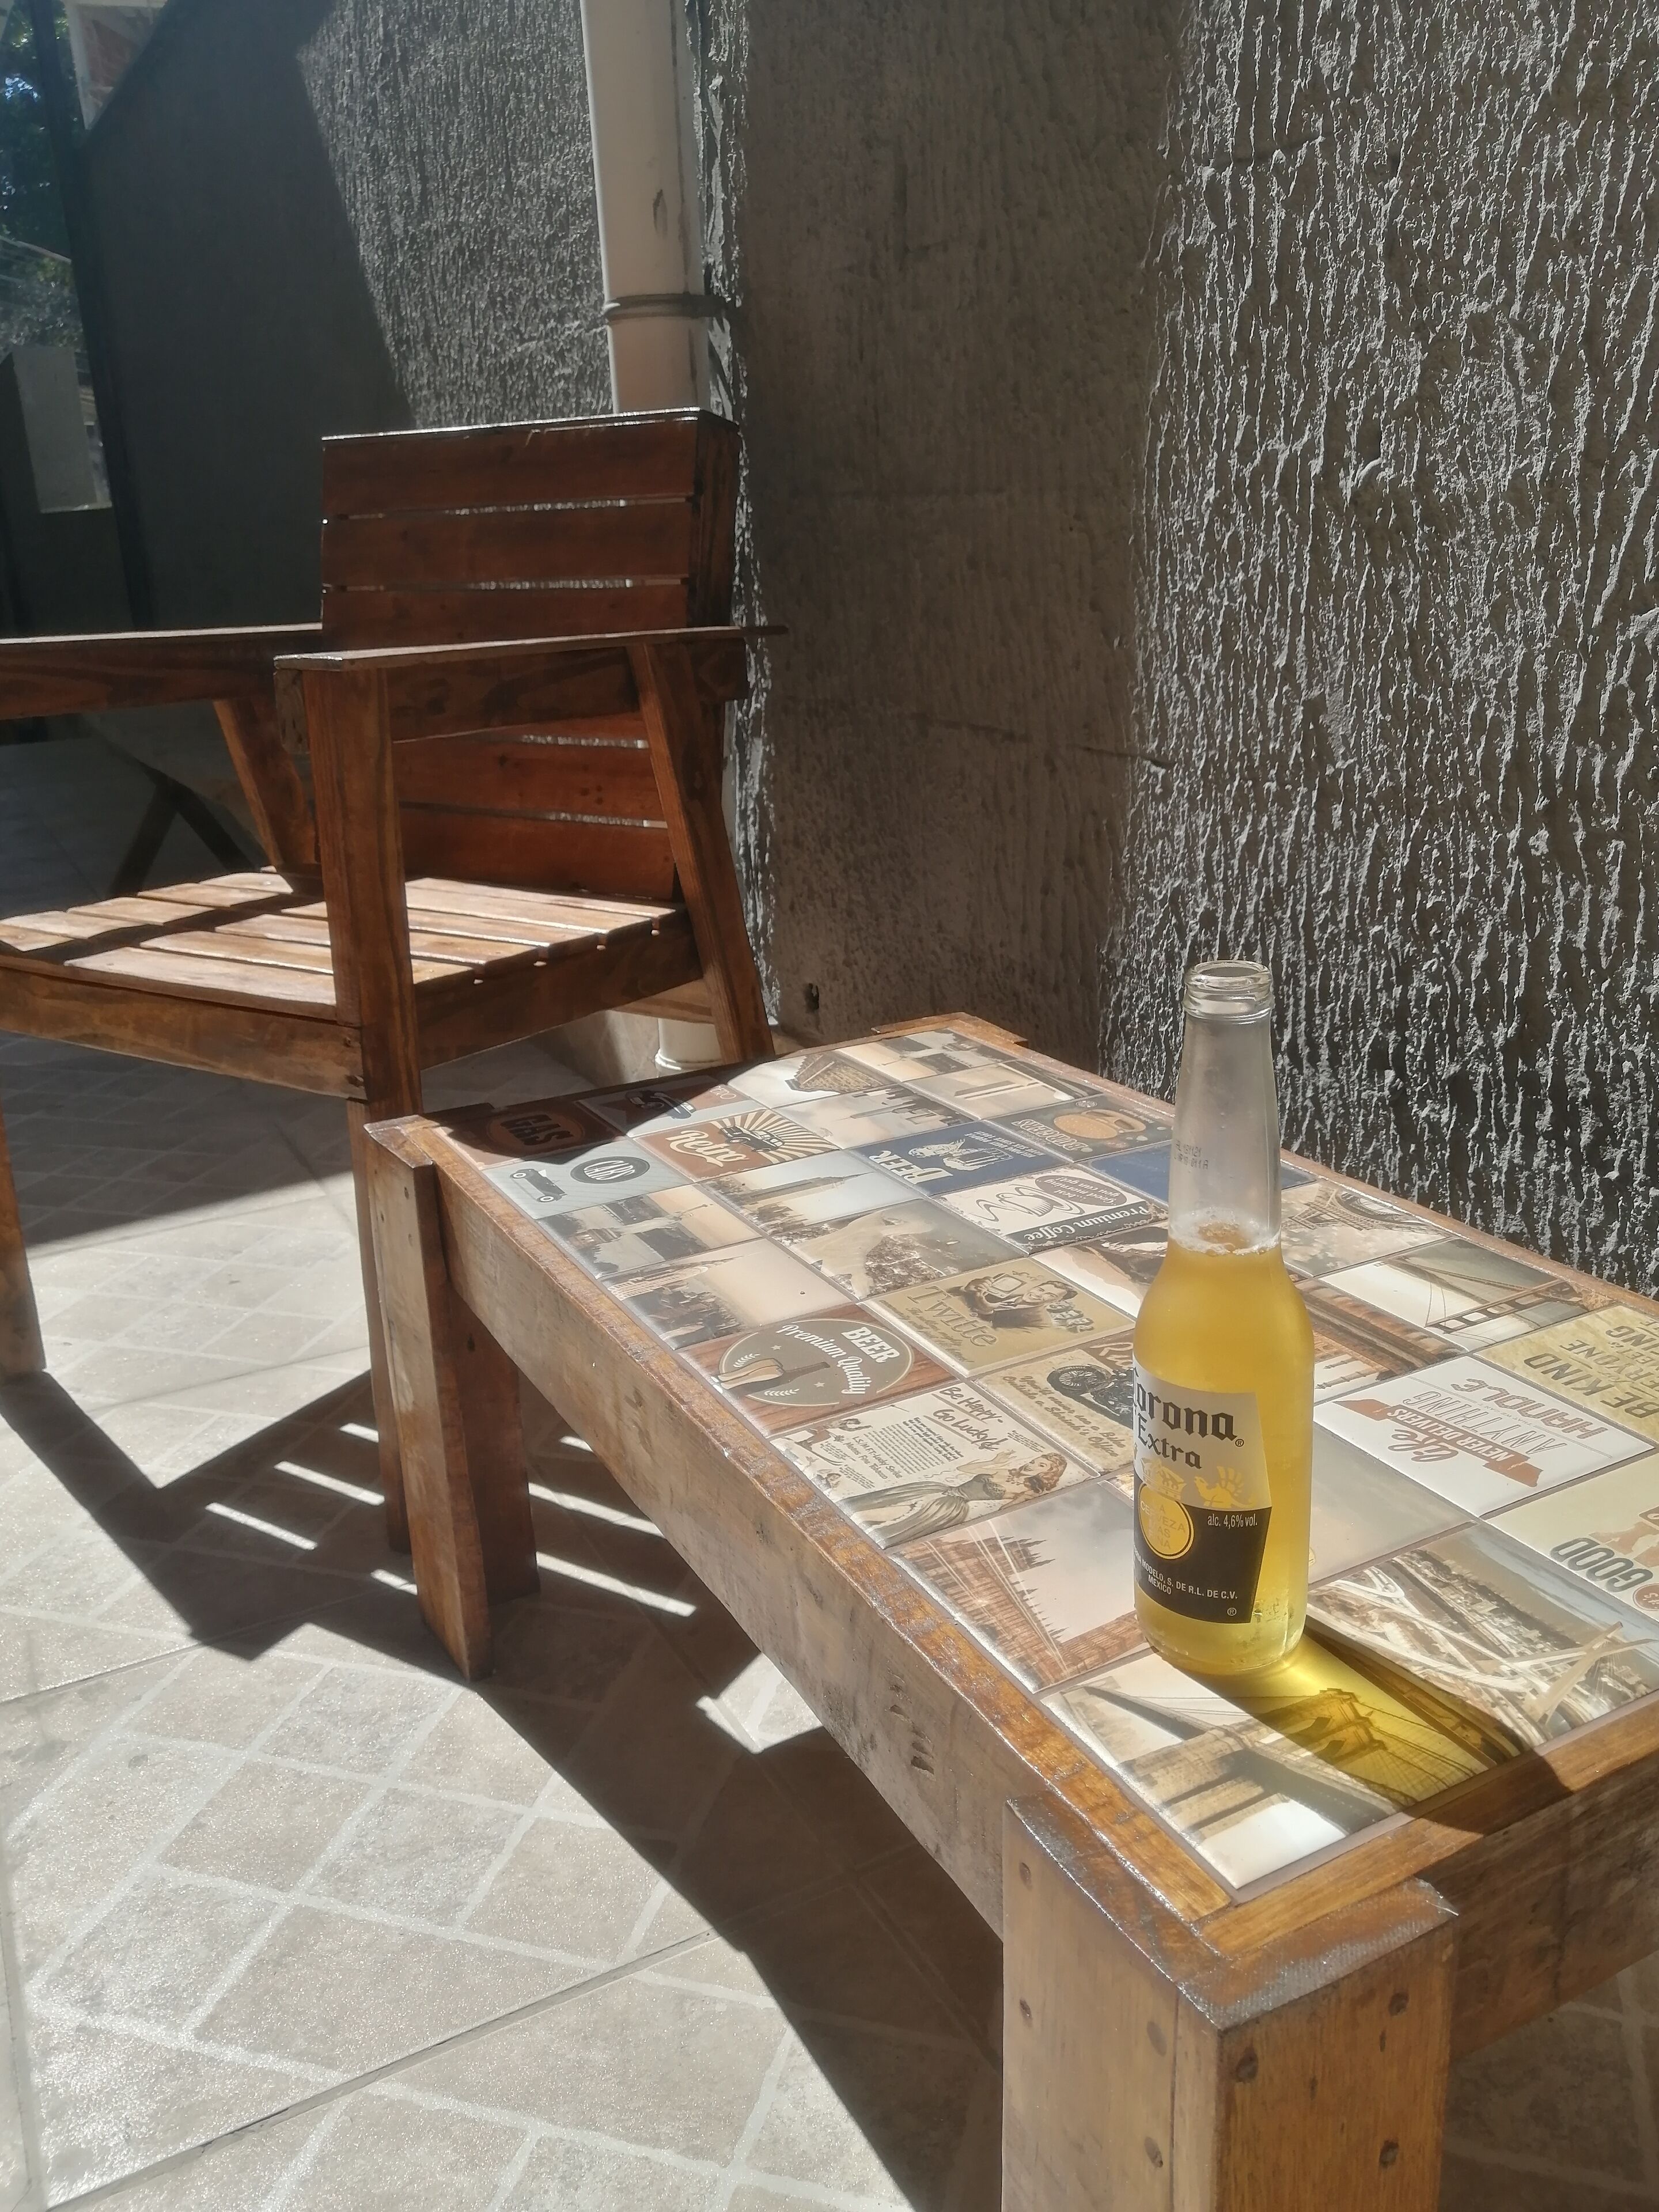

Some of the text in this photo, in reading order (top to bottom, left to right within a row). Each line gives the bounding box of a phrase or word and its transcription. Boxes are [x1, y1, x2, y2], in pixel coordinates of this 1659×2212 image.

[500, 1115, 574, 1145] GAS
[1011, 1119, 1089, 1150] BURGERS
[665, 1130, 749, 1168] Retro
[583, 1160, 635, 1180] CARS
[869, 1150, 953, 1184] BEER
[1024, 1206, 1150, 1241] Premium Coffee
[775, 1324, 872, 1395] Premium Quality
[841, 1327, 900, 1363] BEER
[940, 1387, 964, 1400] Be
[1524, 1353, 1659, 1418] BE KIND
[933, 1409, 955, 1422] Go
[1002, 1376, 1038, 1400] Outside
[1088, 1437, 1118, 1457] Office
[1403, 1391, 1567, 1455] ANYTHING
[1450, 1378, 1608, 1439] HANDLE
[1138, 1412, 1202, 1469] Extra
[1387, 1408, 1514, 1461] NEVER DELIVERS
[1388, 1429, 1459, 1462] life
[1207, 1513, 1257, 1529] alc. 4,6% vol.
[1551, 1537, 1653, 1593] GOOD
[1176, 1581, 1186, 1592] DE
[1188, 1585, 1204, 1596] R.L.
[1207, 1589, 1218, 1599] DE
[1221, 1590, 1238, 1600] C.V.
